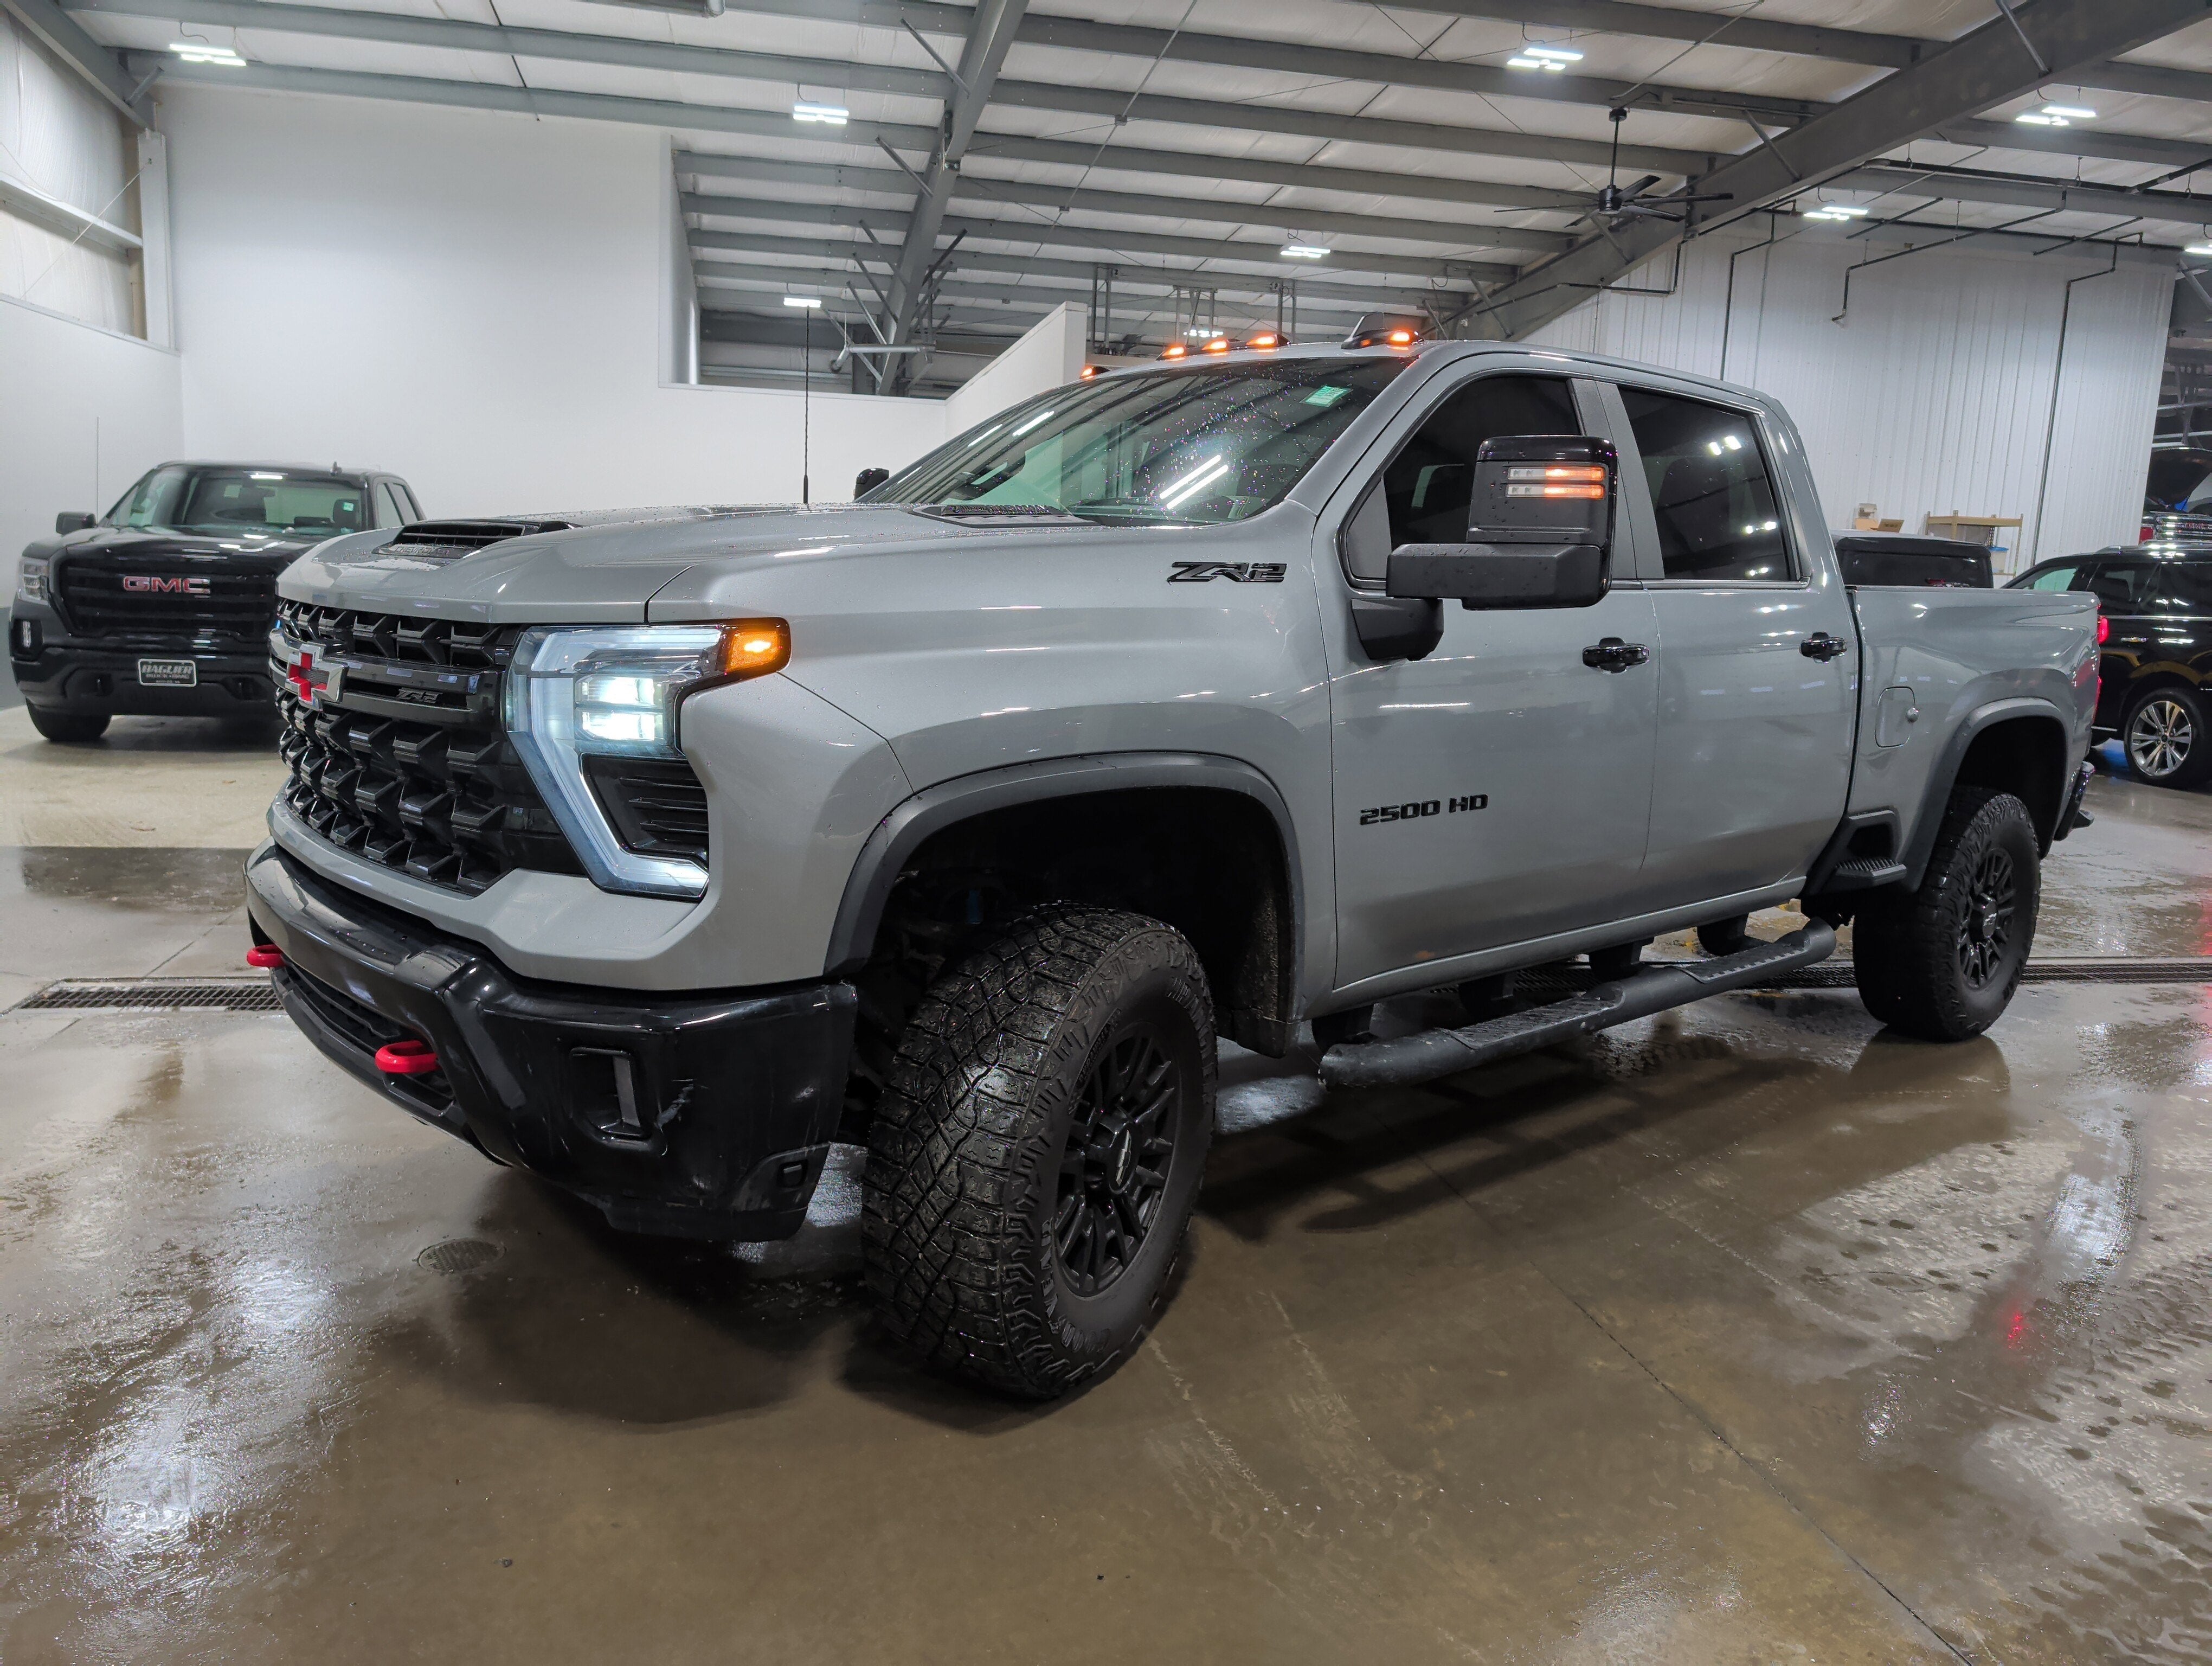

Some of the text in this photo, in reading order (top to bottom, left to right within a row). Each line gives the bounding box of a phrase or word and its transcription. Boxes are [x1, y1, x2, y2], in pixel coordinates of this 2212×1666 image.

[1166, 561, 1288, 583] ZR2
[124, 575, 211, 594] GMC
[396, 687, 443, 704] ZR2
[1360, 793, 1489, 825] 2500 HD
